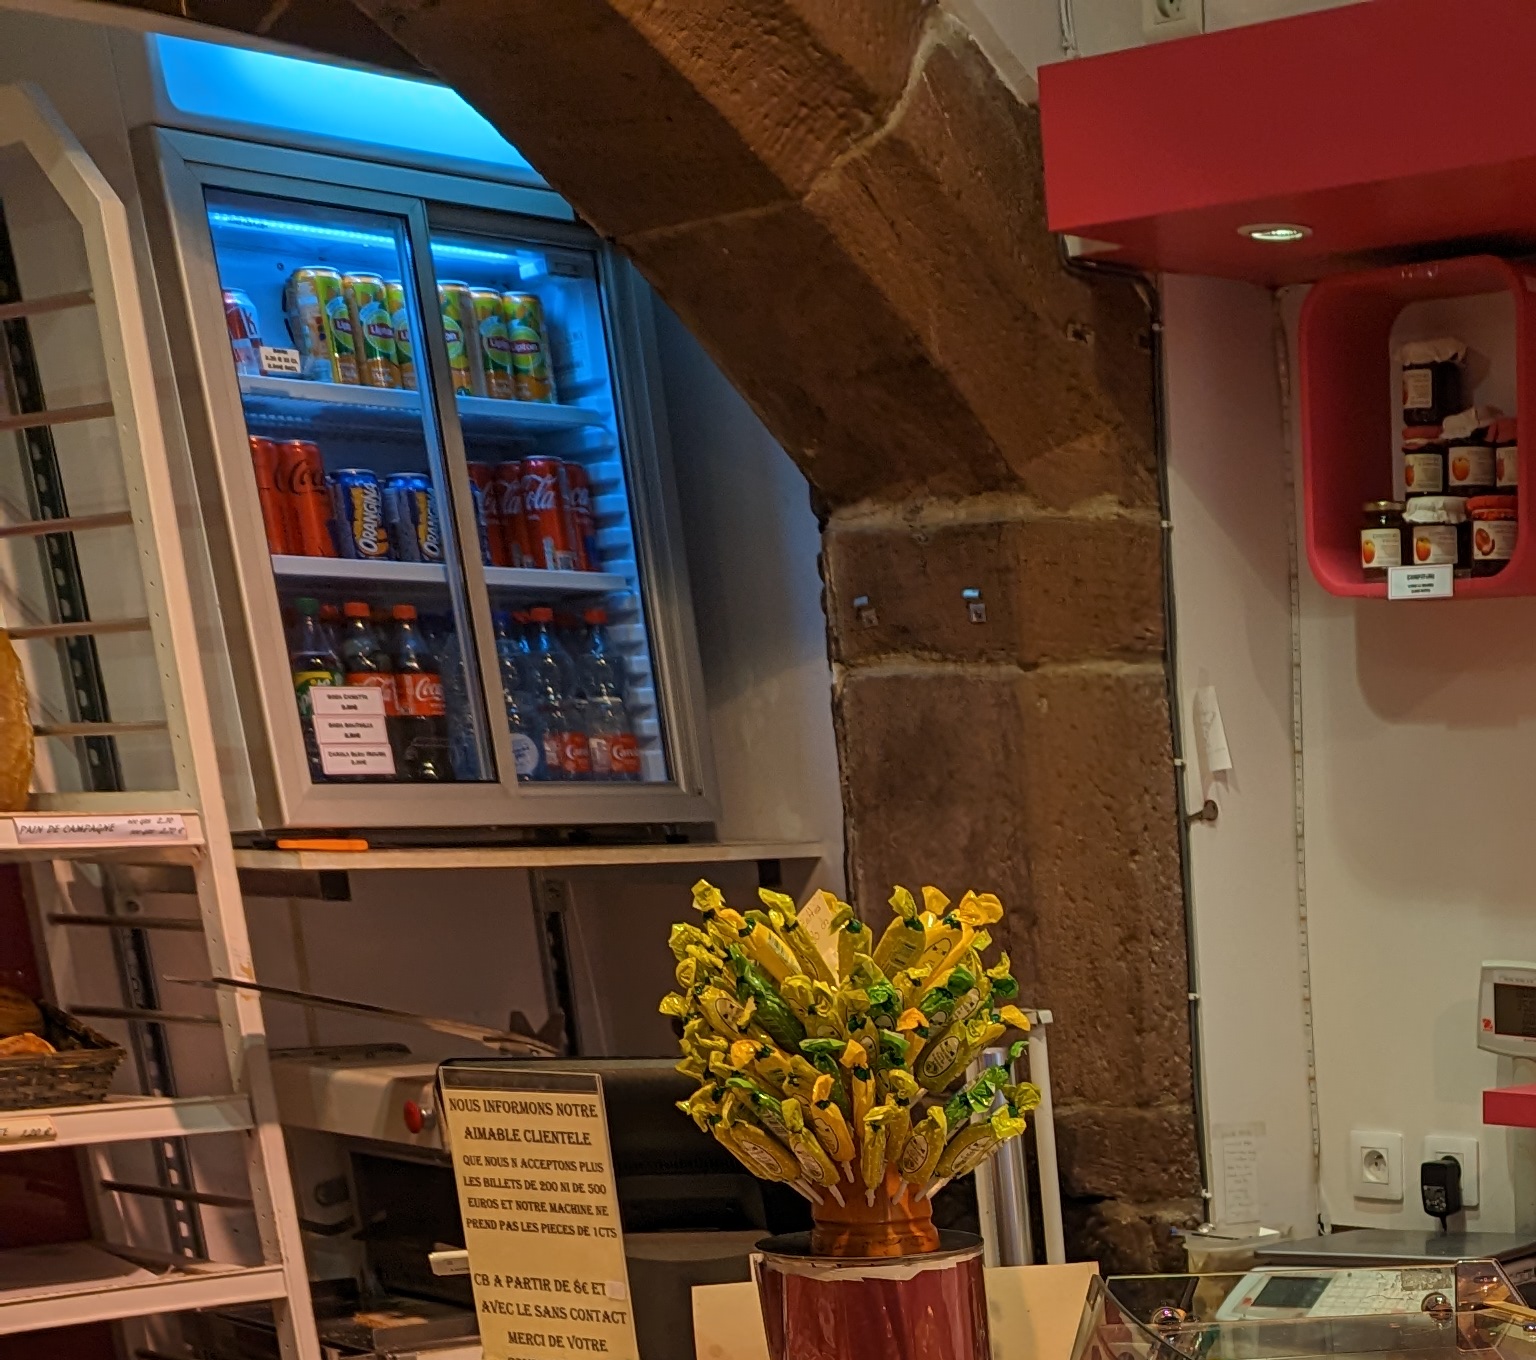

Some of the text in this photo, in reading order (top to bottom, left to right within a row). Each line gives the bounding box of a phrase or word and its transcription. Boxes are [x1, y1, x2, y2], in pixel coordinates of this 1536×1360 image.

[358, 482, 382, 554] ORANGINA
[19, 823, 116, 835] PAIN DE CAMPAGNE
[449, 1098, 598, 1118] NOUS INFORMONS NOTRE
[464, 1126, 592, 1146] AIMABLE CLIENTELE
[463, 1155, 604, 1173] QUE NOUS N ACCEPTONS PLUS
[463, 1176, 607, 1195] LES BILLETS DE 200 NI DE 500
[467, 1197, 609, 1217] EUROS ET NOTRE MACHINE NE
[466, 1218, 497, 1230] PREND
[500, 1220, 519, 1232] PAS
[521, 1222, 540, 1233] LES
[541, 1223, 575, 1236] PIECES
[577, 1225, 590, 1237] DE
[474, 1272, 490, 1286] CB
[493, 1275, 503, 1287] A
[506, 1275, 552, 1292] PARTIR
[554, 1280, 571, 1293] DE
[591, 1282, 607, 1296] ET
[481, 1300, 627, 1325] AVEC LE SANS CONTACT
[507, 1331, 609, 1353] MERCI DE VOTRE
